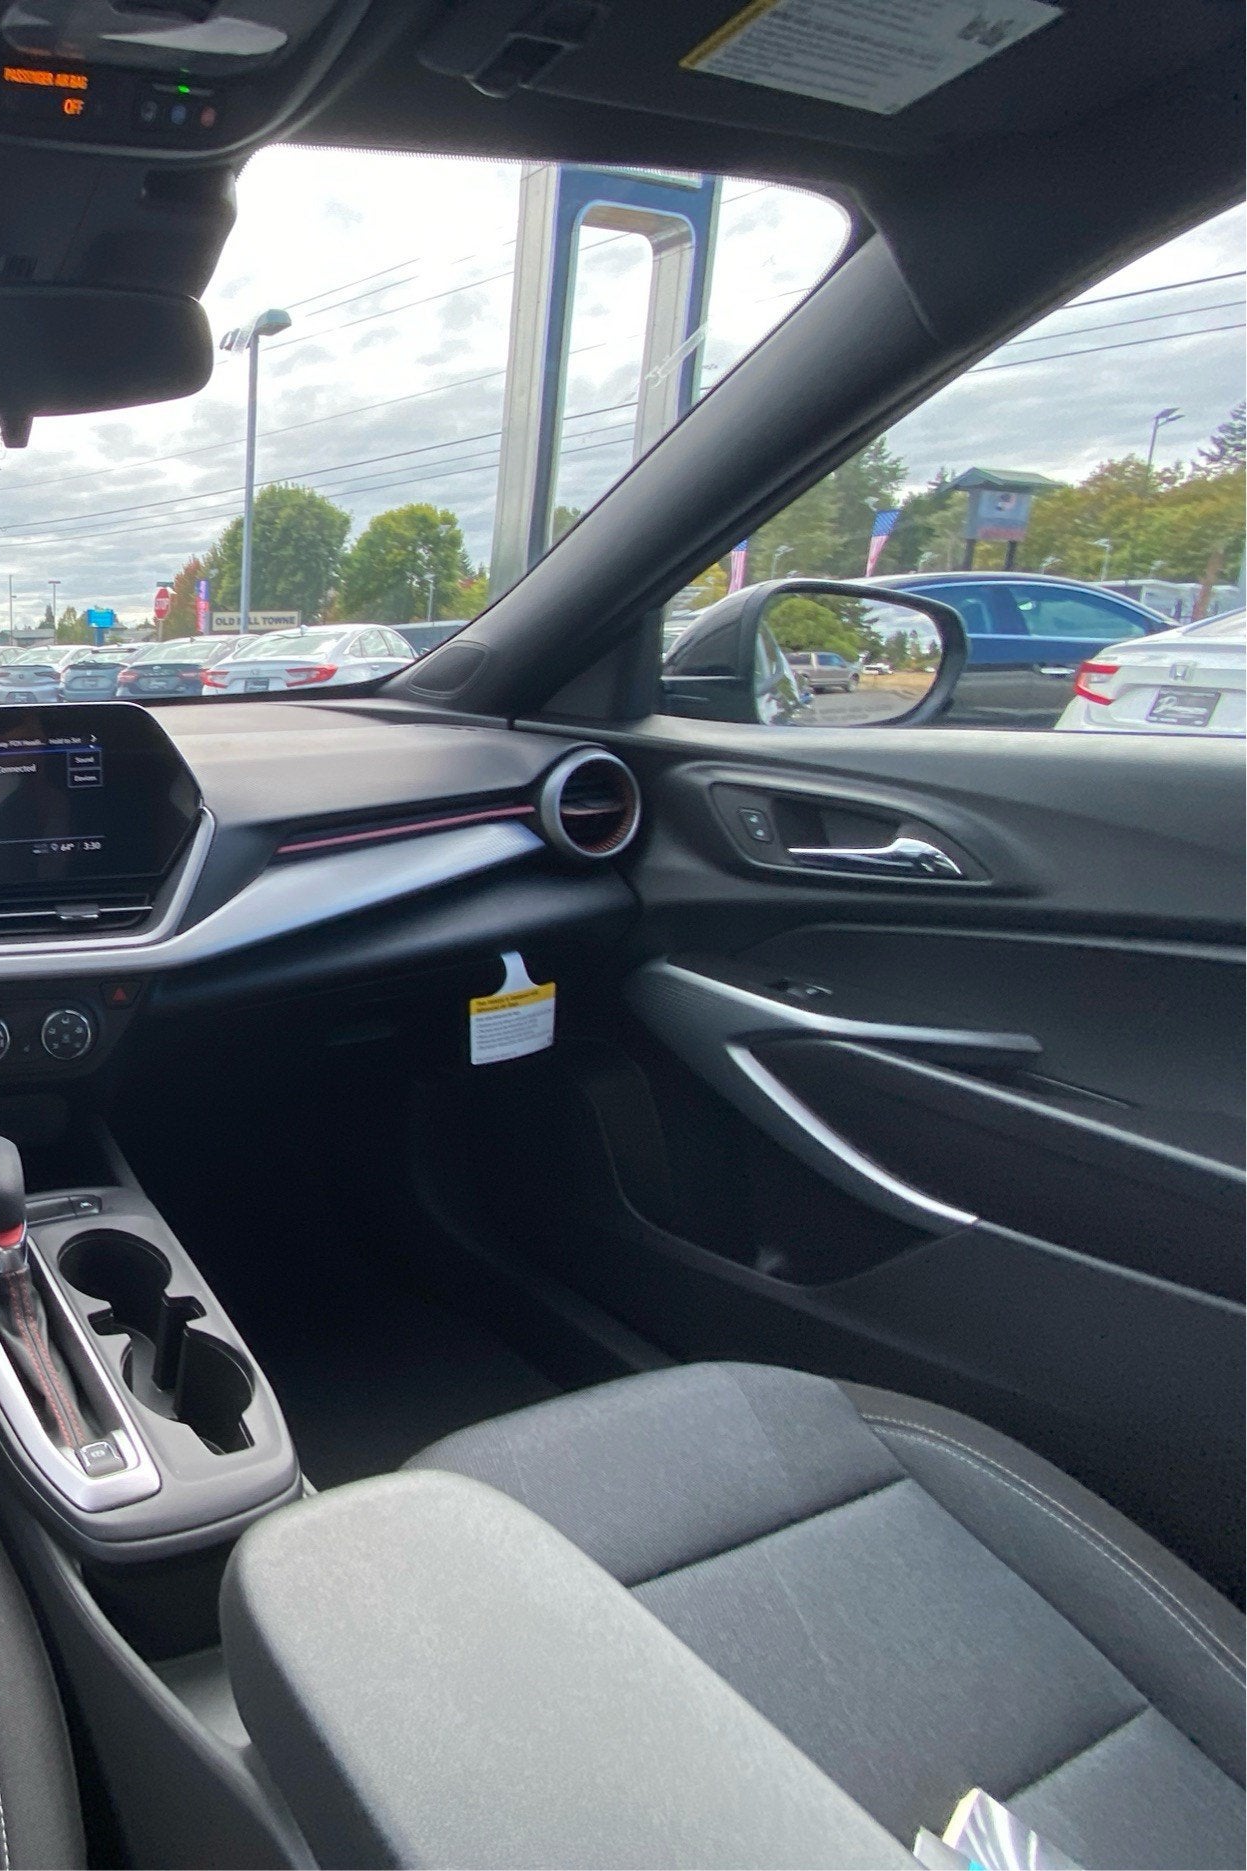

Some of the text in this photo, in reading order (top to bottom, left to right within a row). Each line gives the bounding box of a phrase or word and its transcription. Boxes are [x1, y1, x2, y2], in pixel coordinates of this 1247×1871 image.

[215, 617, 235, 626] OLD
[260, 615, 295, 625] TOWNE
[83, 841, 102, 851] 3:30
